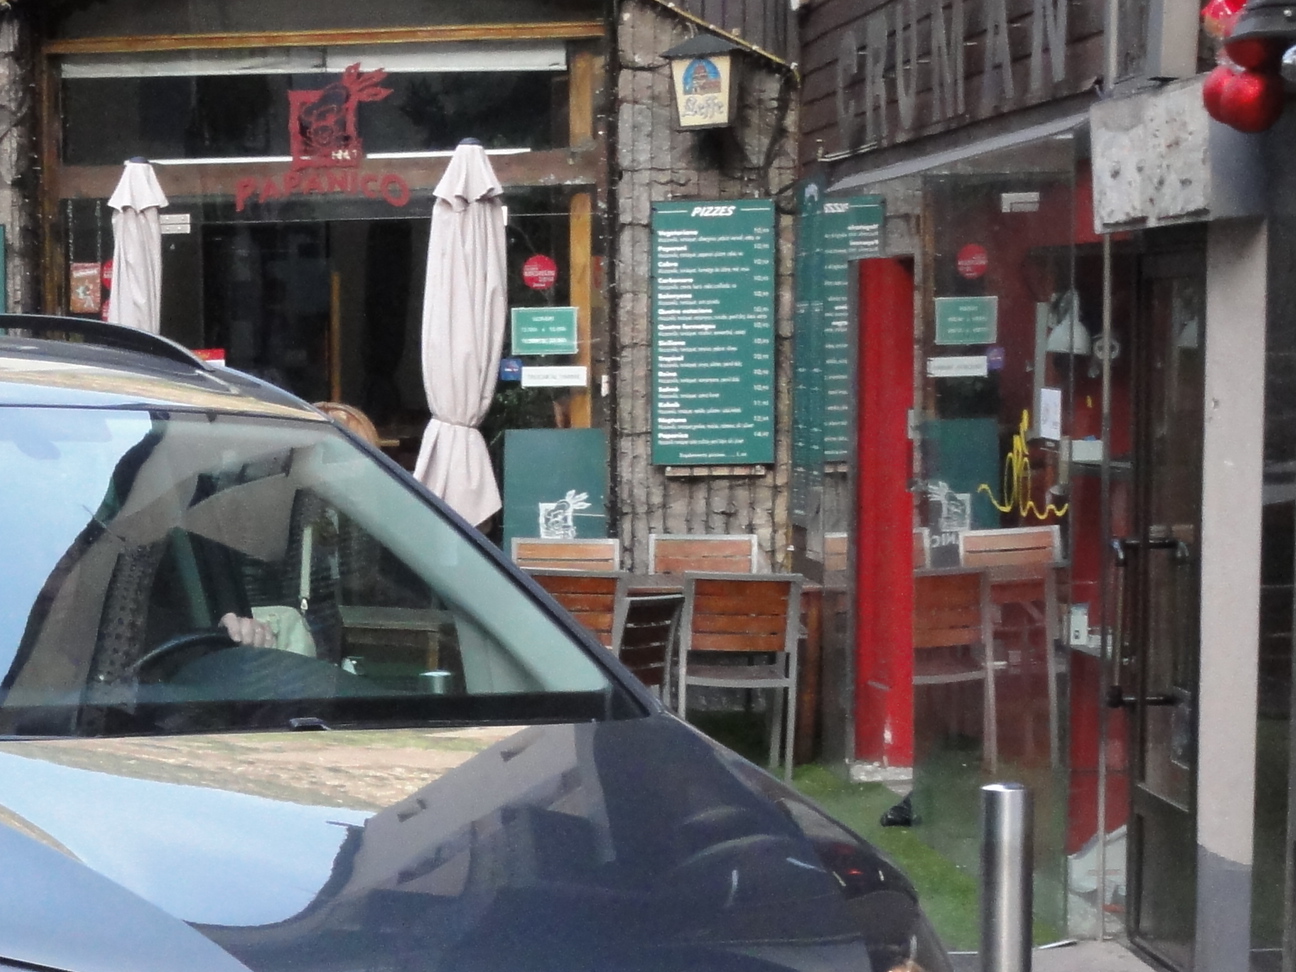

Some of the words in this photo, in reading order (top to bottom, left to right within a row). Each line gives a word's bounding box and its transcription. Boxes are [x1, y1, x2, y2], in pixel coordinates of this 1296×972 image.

[682, 95, 725, 119] Leffe
[234, 169, 411, 213] PAPANICO
[690, 205, 737, 217] PIZZES
